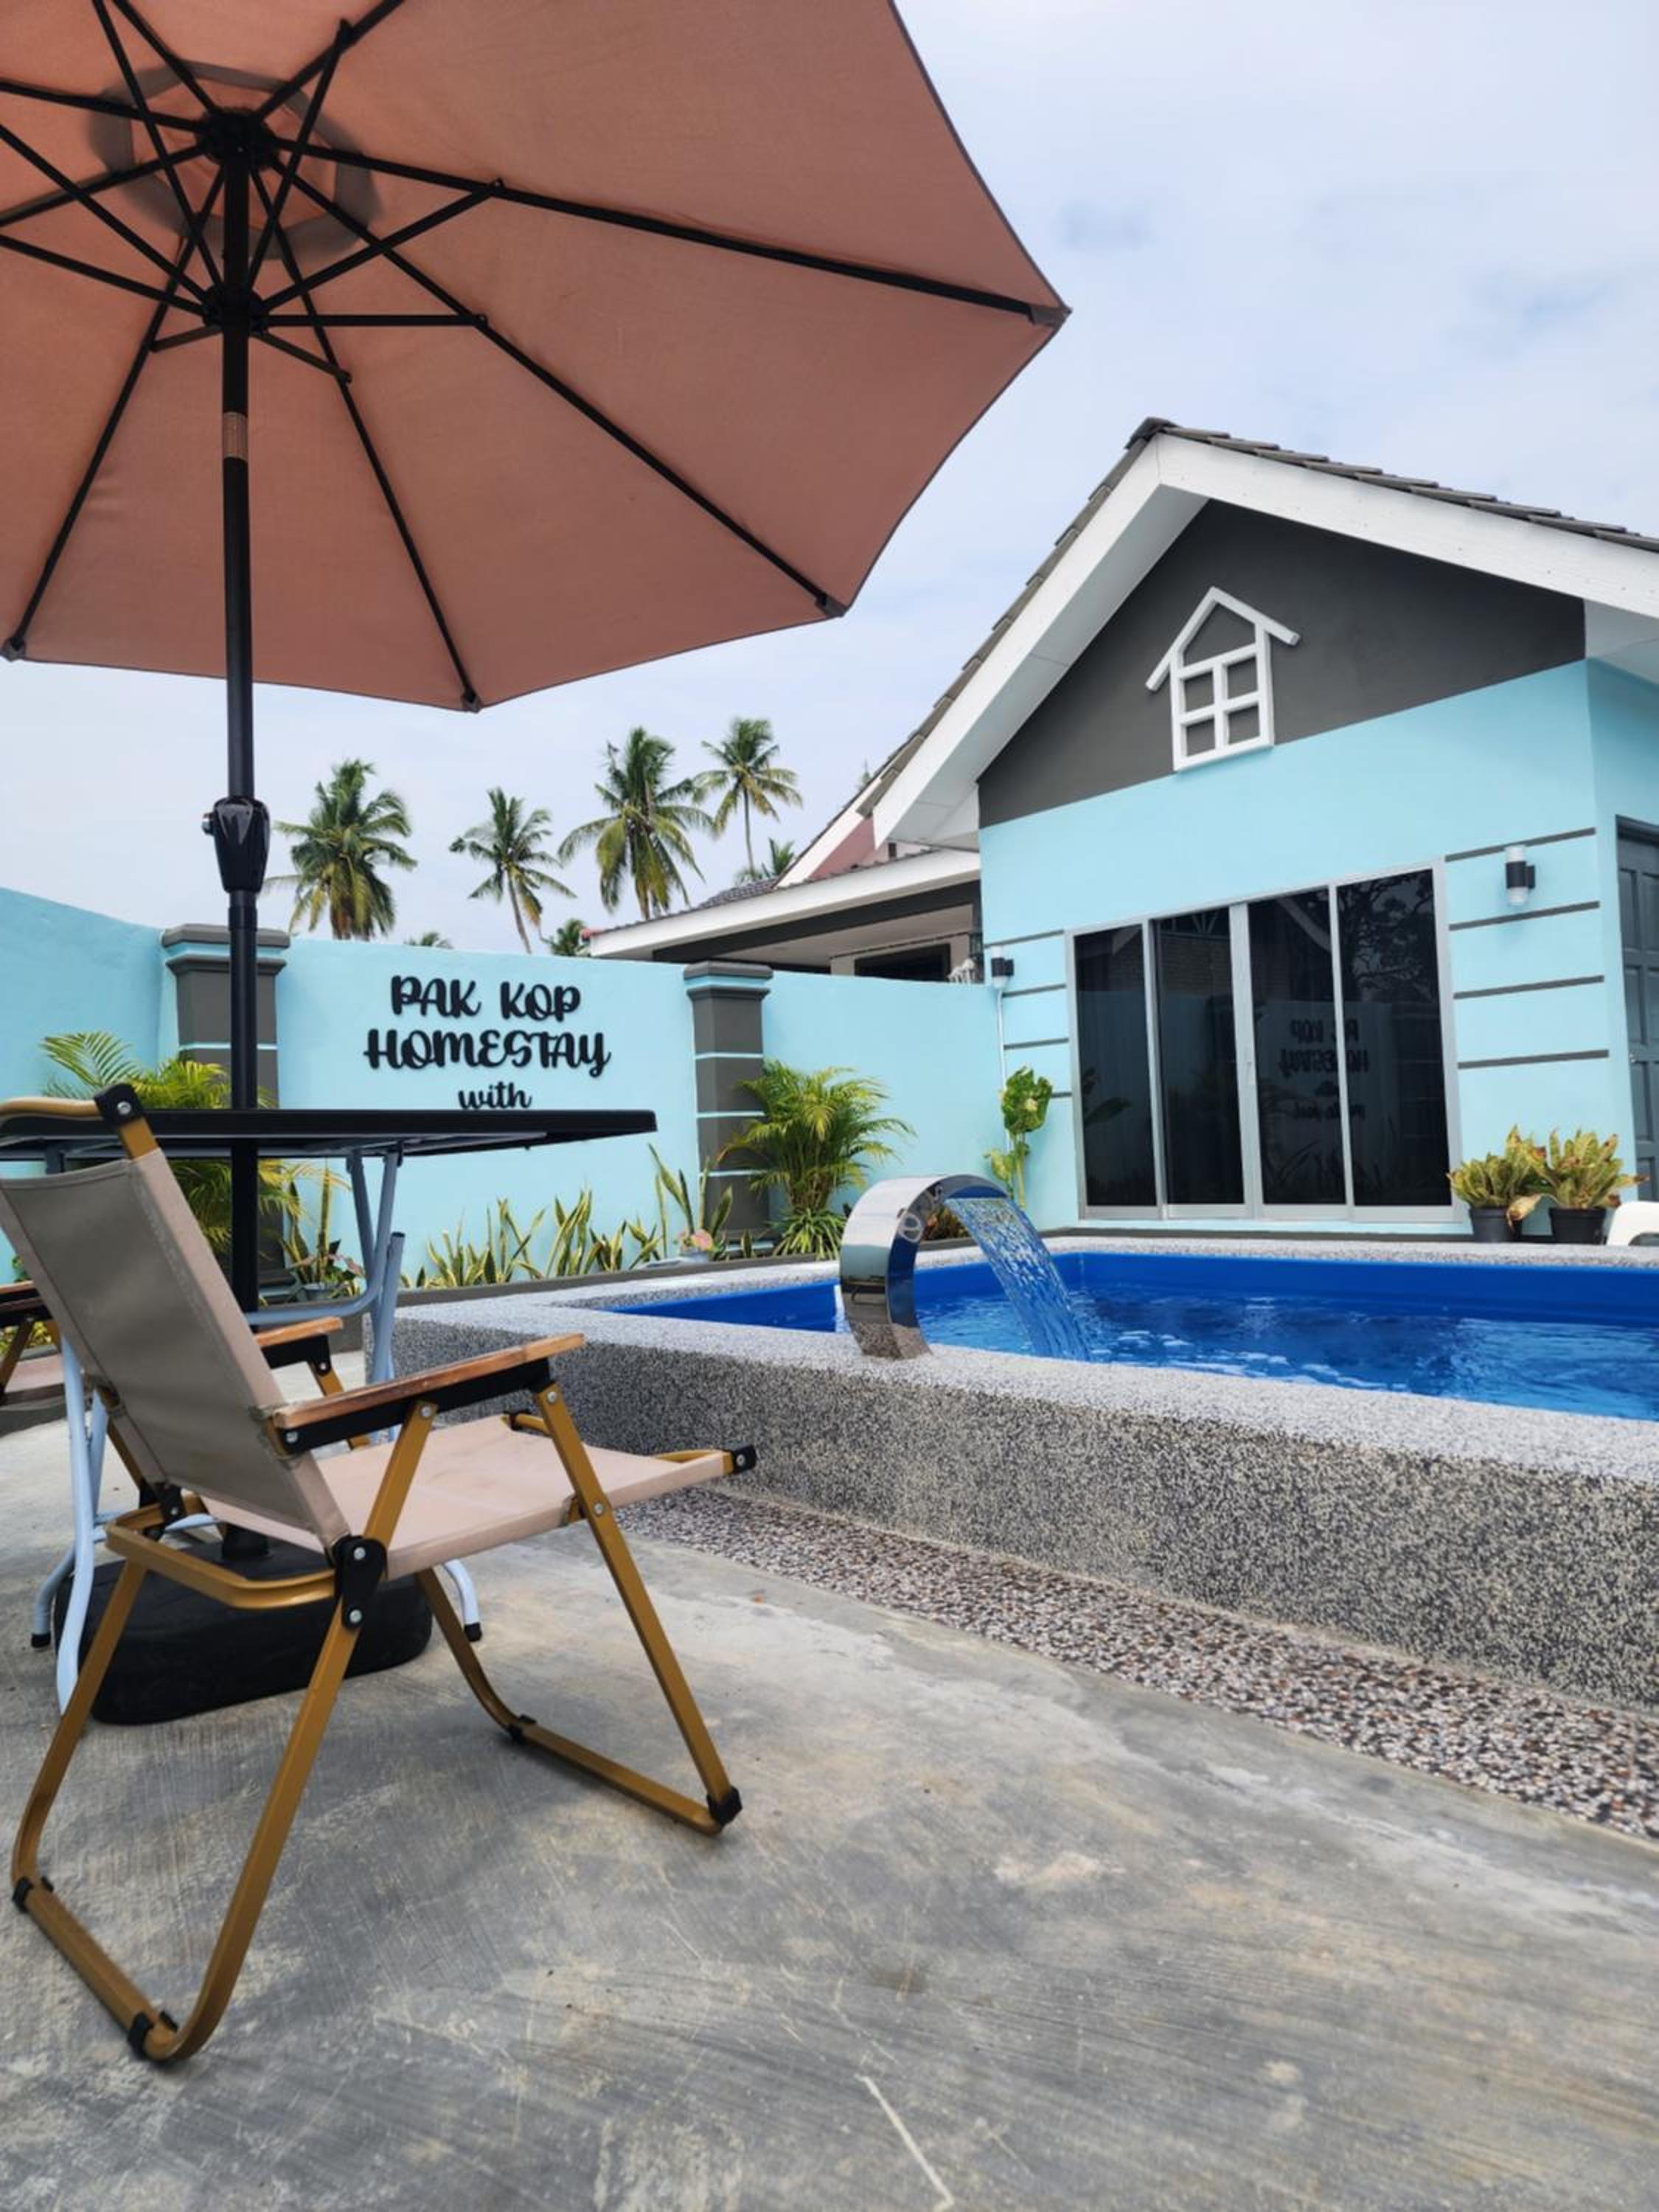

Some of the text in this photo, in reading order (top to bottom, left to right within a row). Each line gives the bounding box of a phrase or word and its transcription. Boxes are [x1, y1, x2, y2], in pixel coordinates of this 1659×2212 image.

[391, 975, 581, 1022] PAK KOP
[364, 1029, 612, 1078] HOMESTAY
[458, 1082, 532, 1110] with
